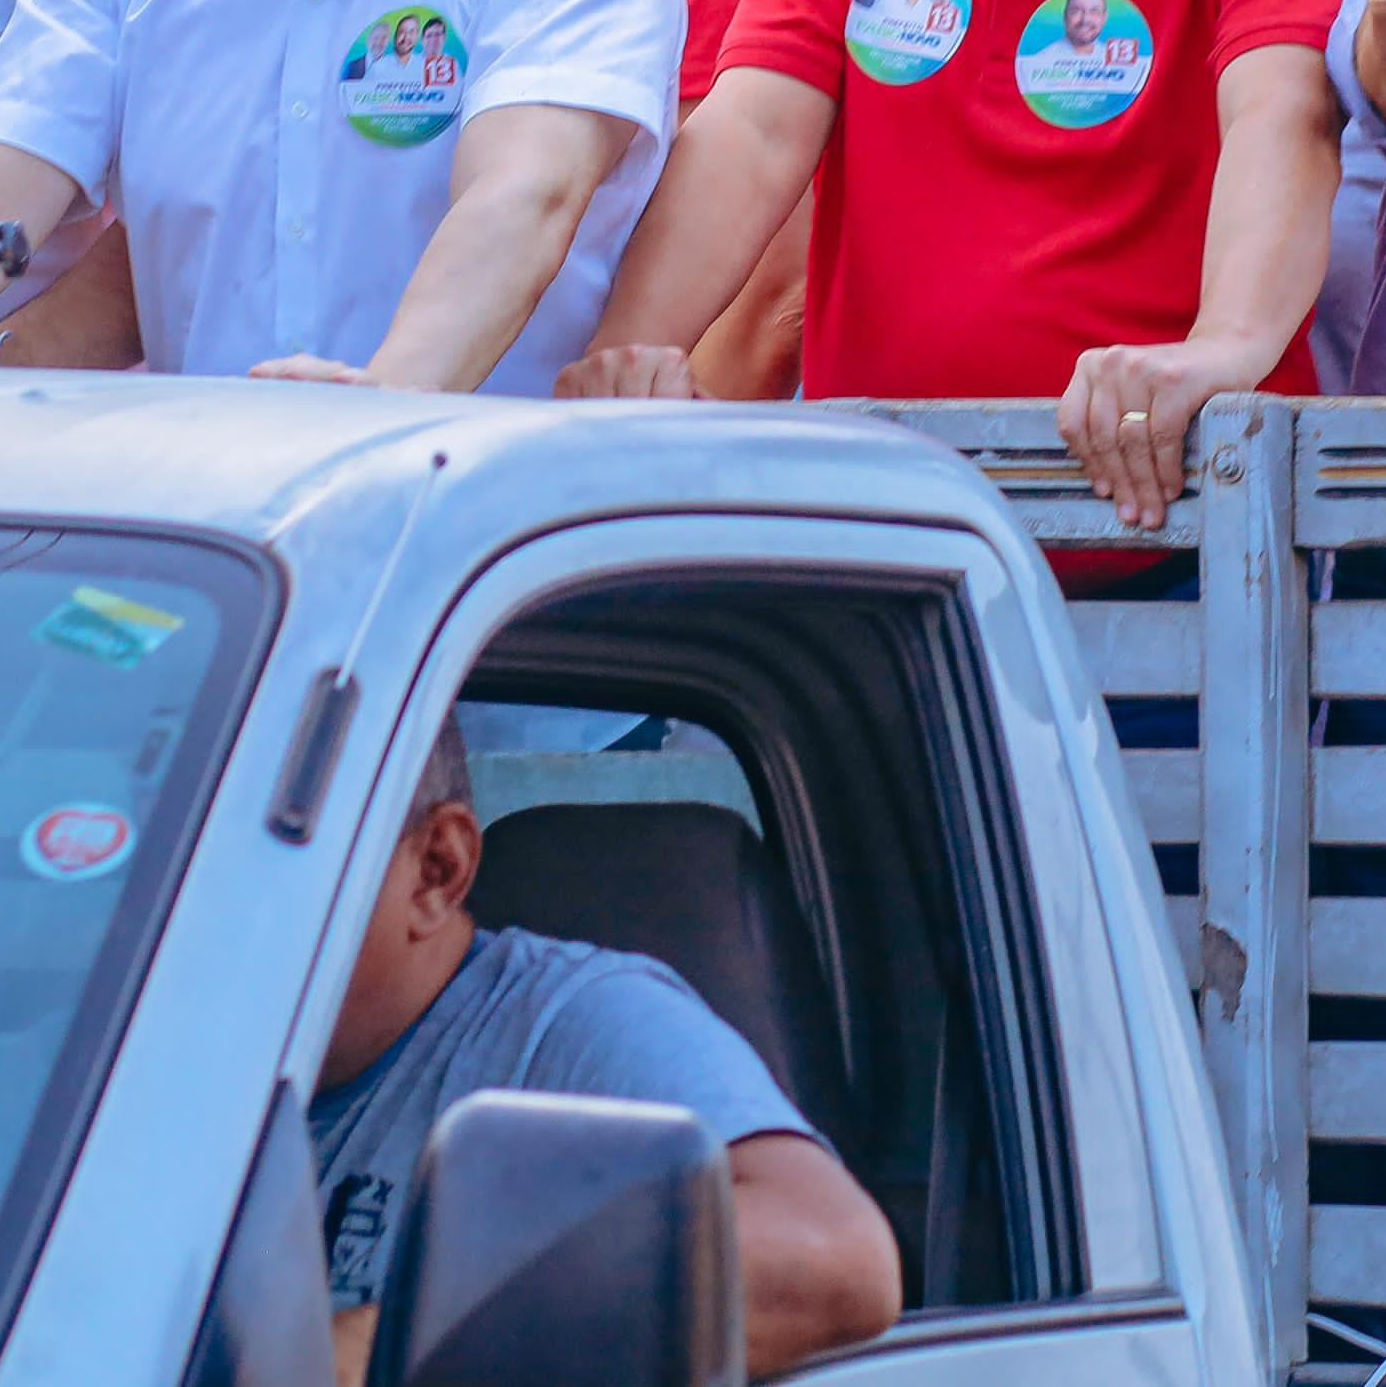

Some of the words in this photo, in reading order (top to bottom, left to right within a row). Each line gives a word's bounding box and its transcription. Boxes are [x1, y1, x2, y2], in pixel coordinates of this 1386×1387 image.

[929, 6, 957, 33] 13
[1108, 39, 1136, 65] 13
[425, 58, 454, 85] 13
